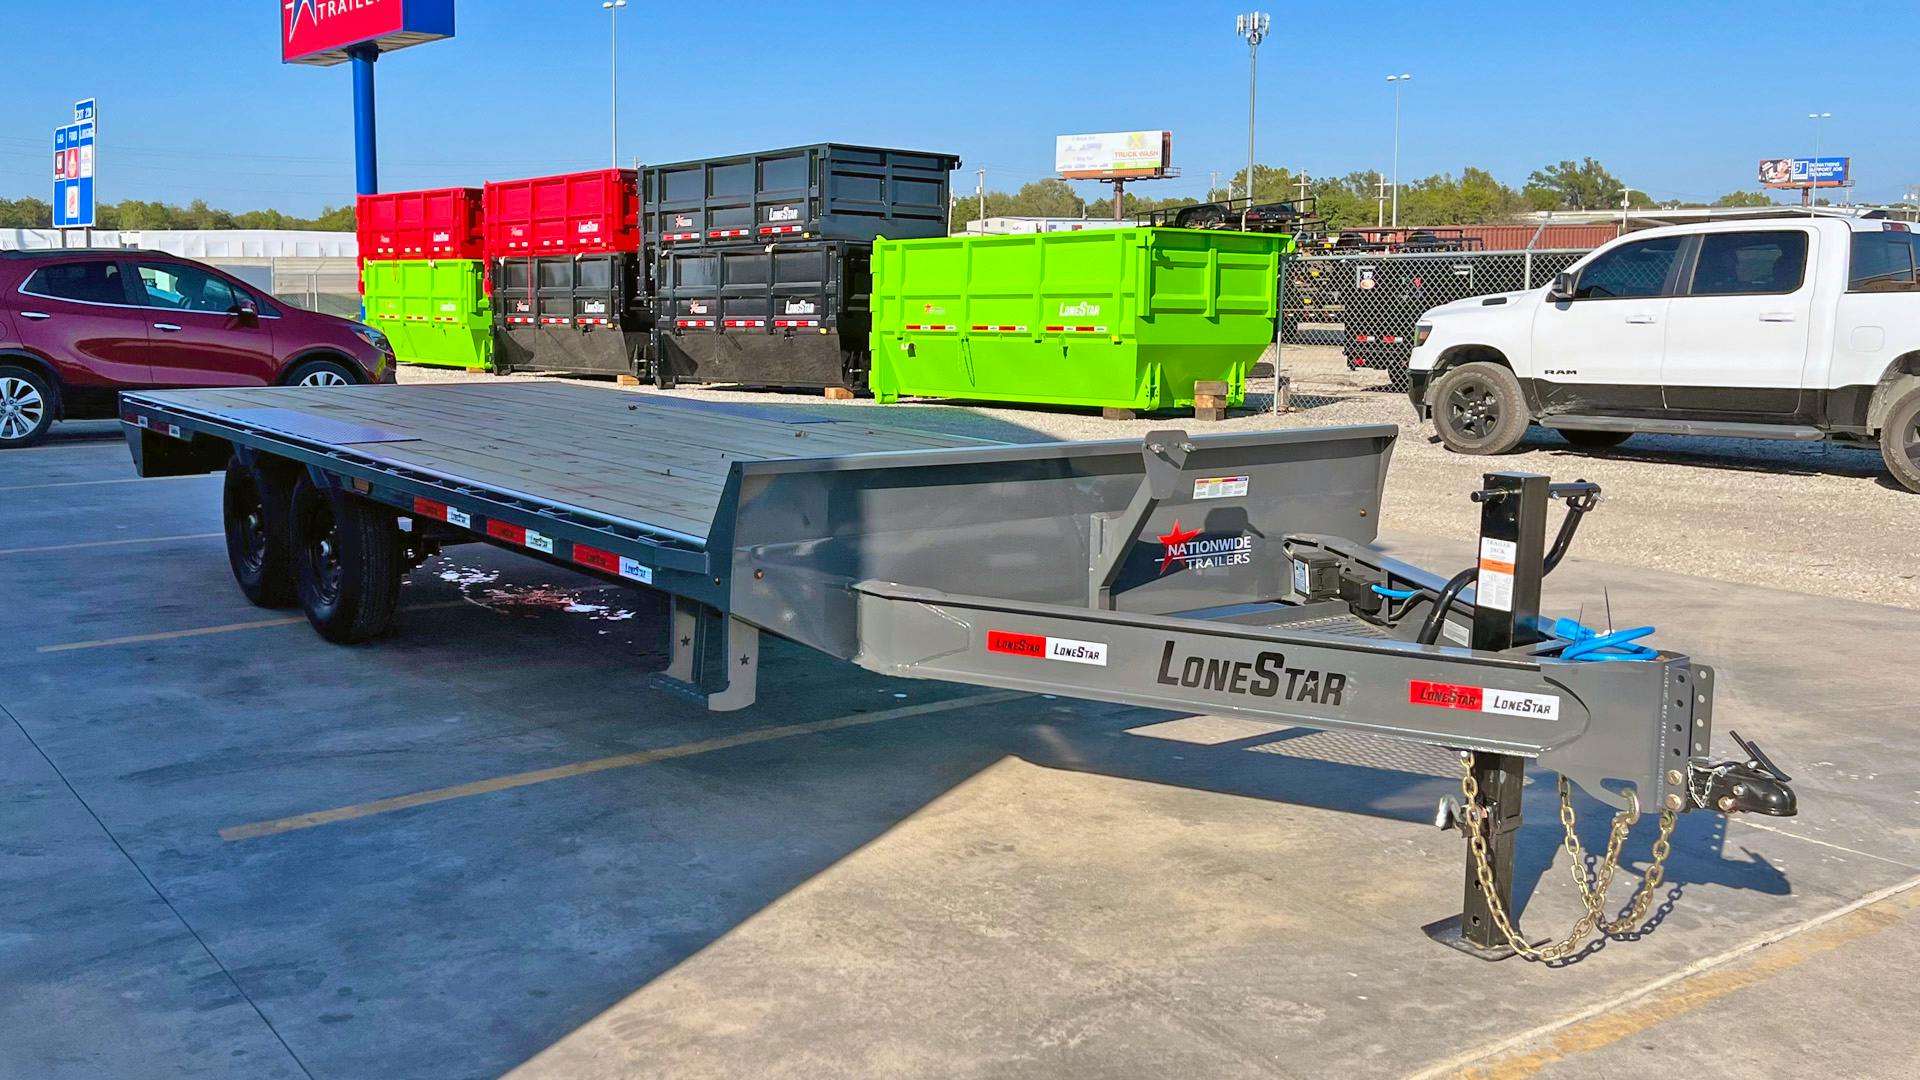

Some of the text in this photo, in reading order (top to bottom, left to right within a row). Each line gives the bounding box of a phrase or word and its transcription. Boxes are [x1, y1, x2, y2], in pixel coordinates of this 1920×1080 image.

[1114, 149, 1159, 158] TRUCK WASH
[1168, 535, 1252, 556] NATIONWIDE
[1186, 553, 1251, 570] TRAILERS
